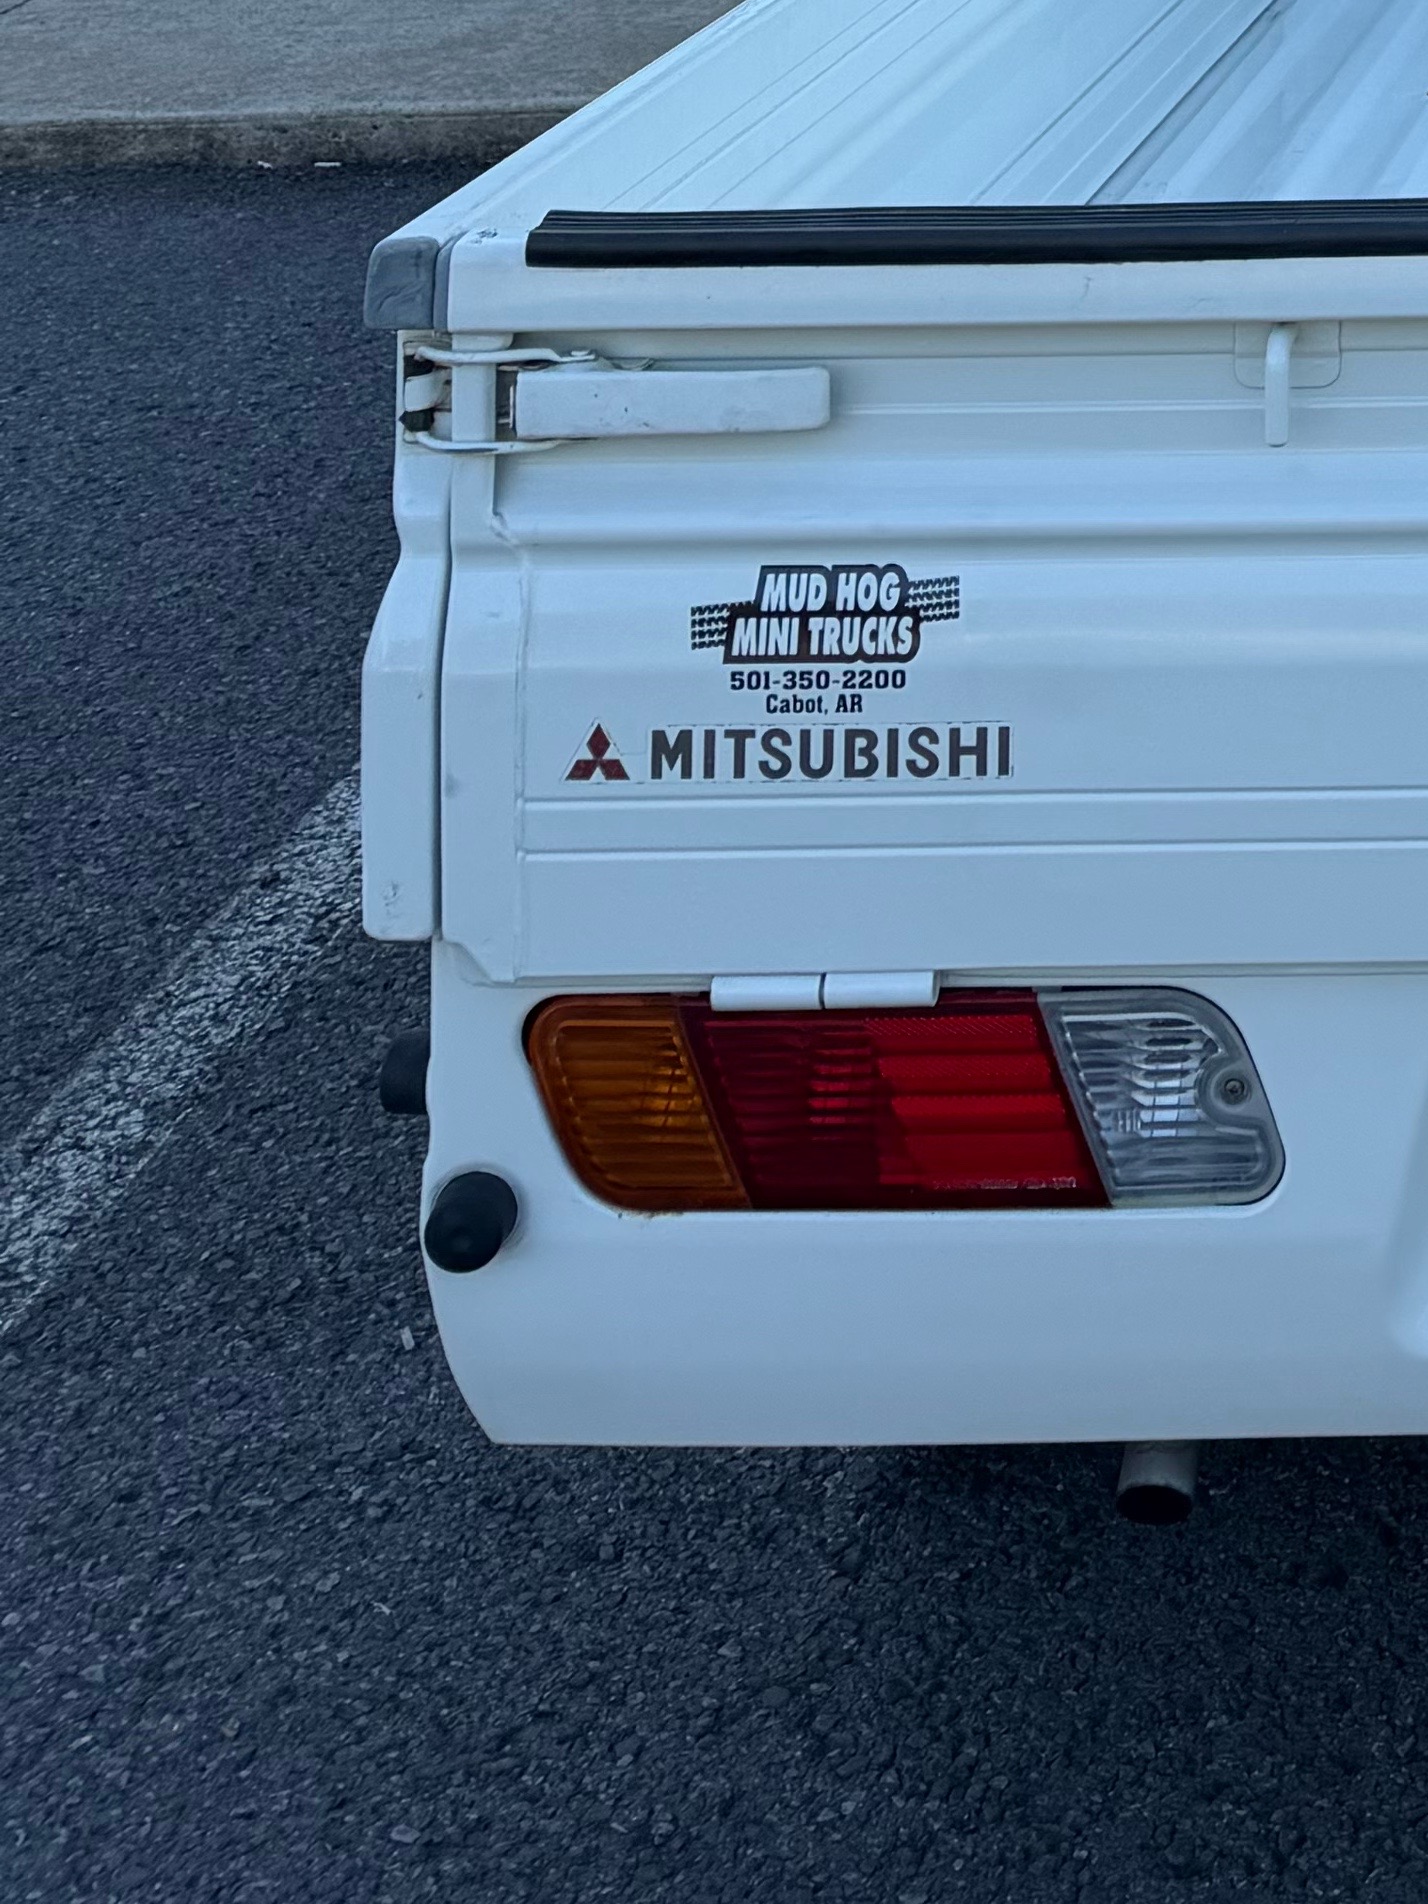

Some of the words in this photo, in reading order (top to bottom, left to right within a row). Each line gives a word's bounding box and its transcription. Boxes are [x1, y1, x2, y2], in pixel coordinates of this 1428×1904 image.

[760, 572, 828, 612] MUD
[837, 571, 902, 611] HOG
[731, 617, 799, 657] MINI
[807, 615, 913, 656] TRUCKS
[729, 669, 907, 691] 501-350-2200
[765, 693, 830, 715] Cabot,
[834, 693, 863, 714] AR
[650, 725, 1011, 780] MITSUBISHI
